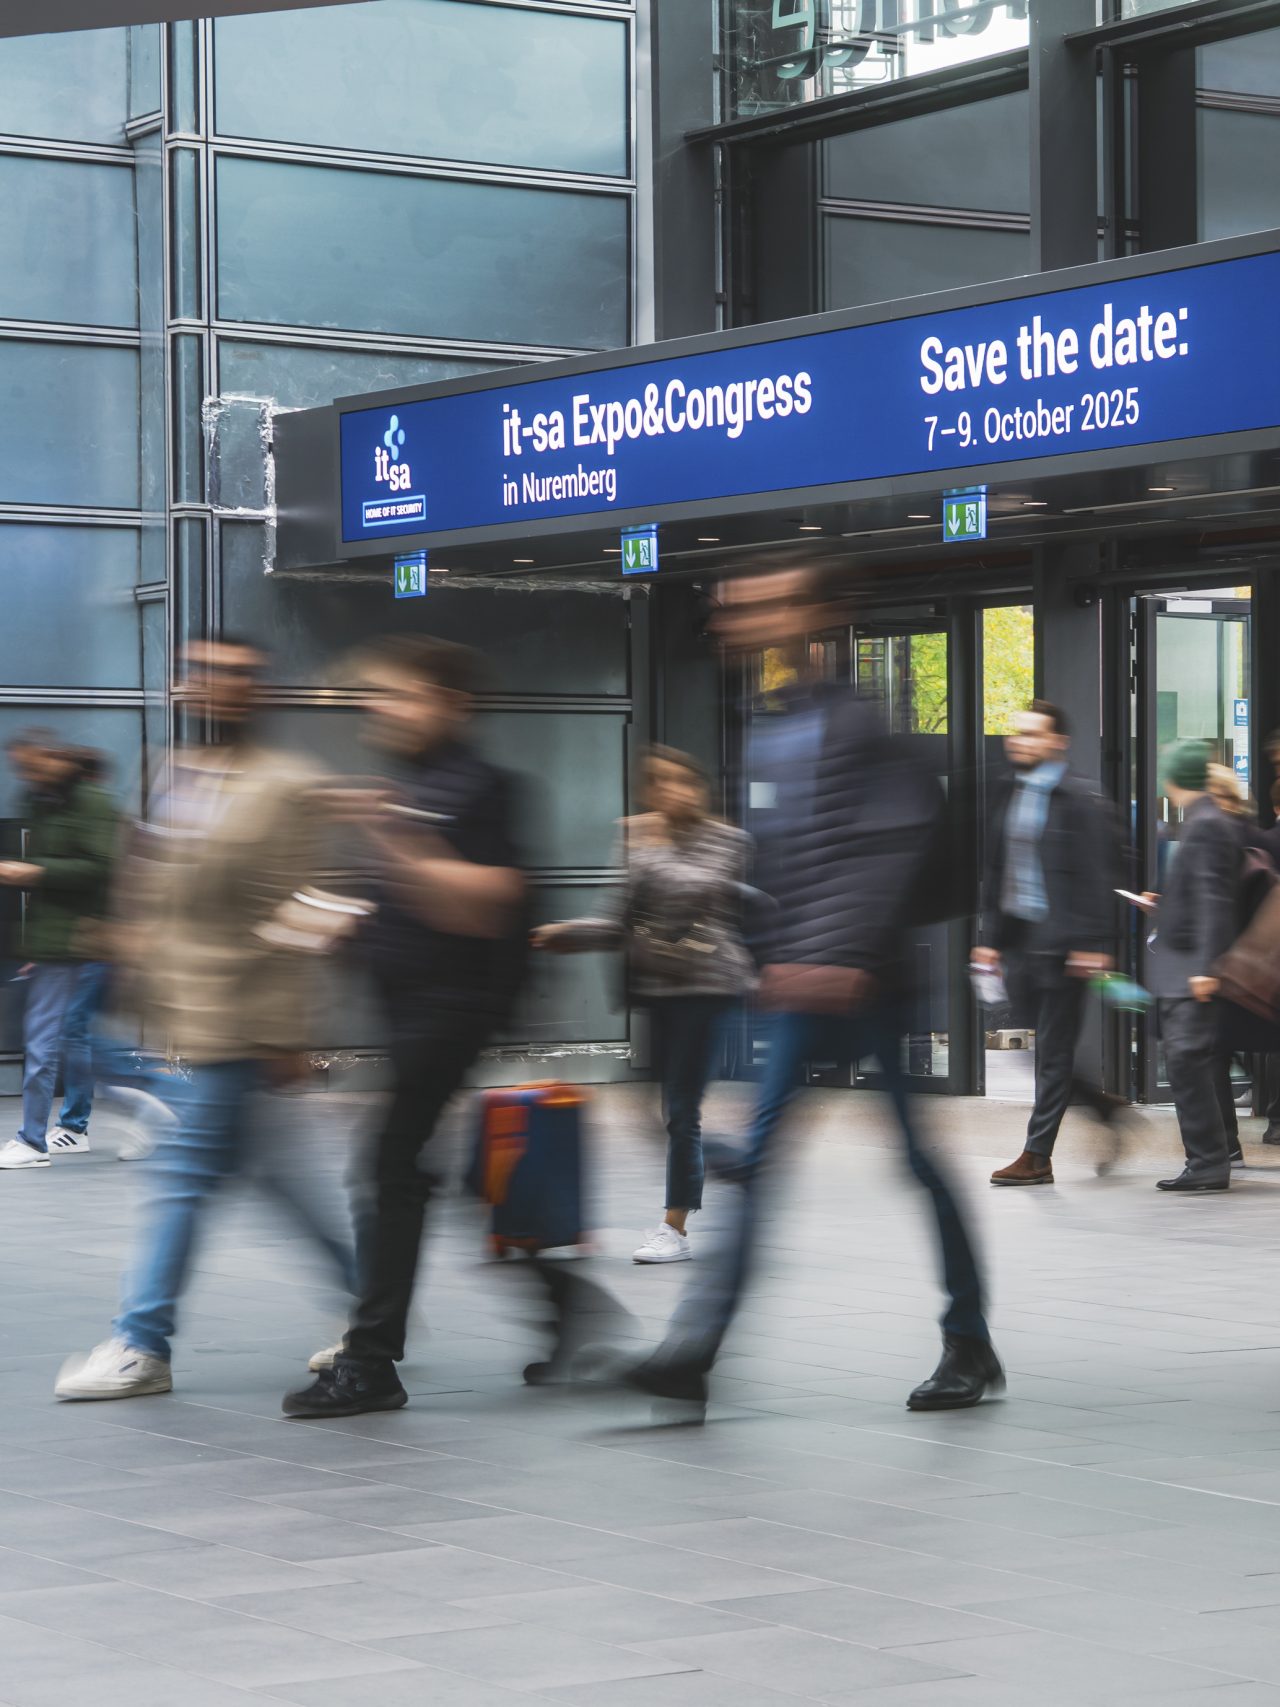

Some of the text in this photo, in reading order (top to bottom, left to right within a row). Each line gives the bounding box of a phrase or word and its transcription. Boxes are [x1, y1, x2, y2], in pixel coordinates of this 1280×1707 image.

[920, 303, 1189, 395] Save the date:
[502, 370, 813, 457] it-sa Expo&Congress
[984, 398, 1076, 444] October
[1080, 386, 1141, 432] 2025
[365, 502, 423, 519] HOME OF IT SECURITY
[502, 463, 618, 507] in Nuremberg
